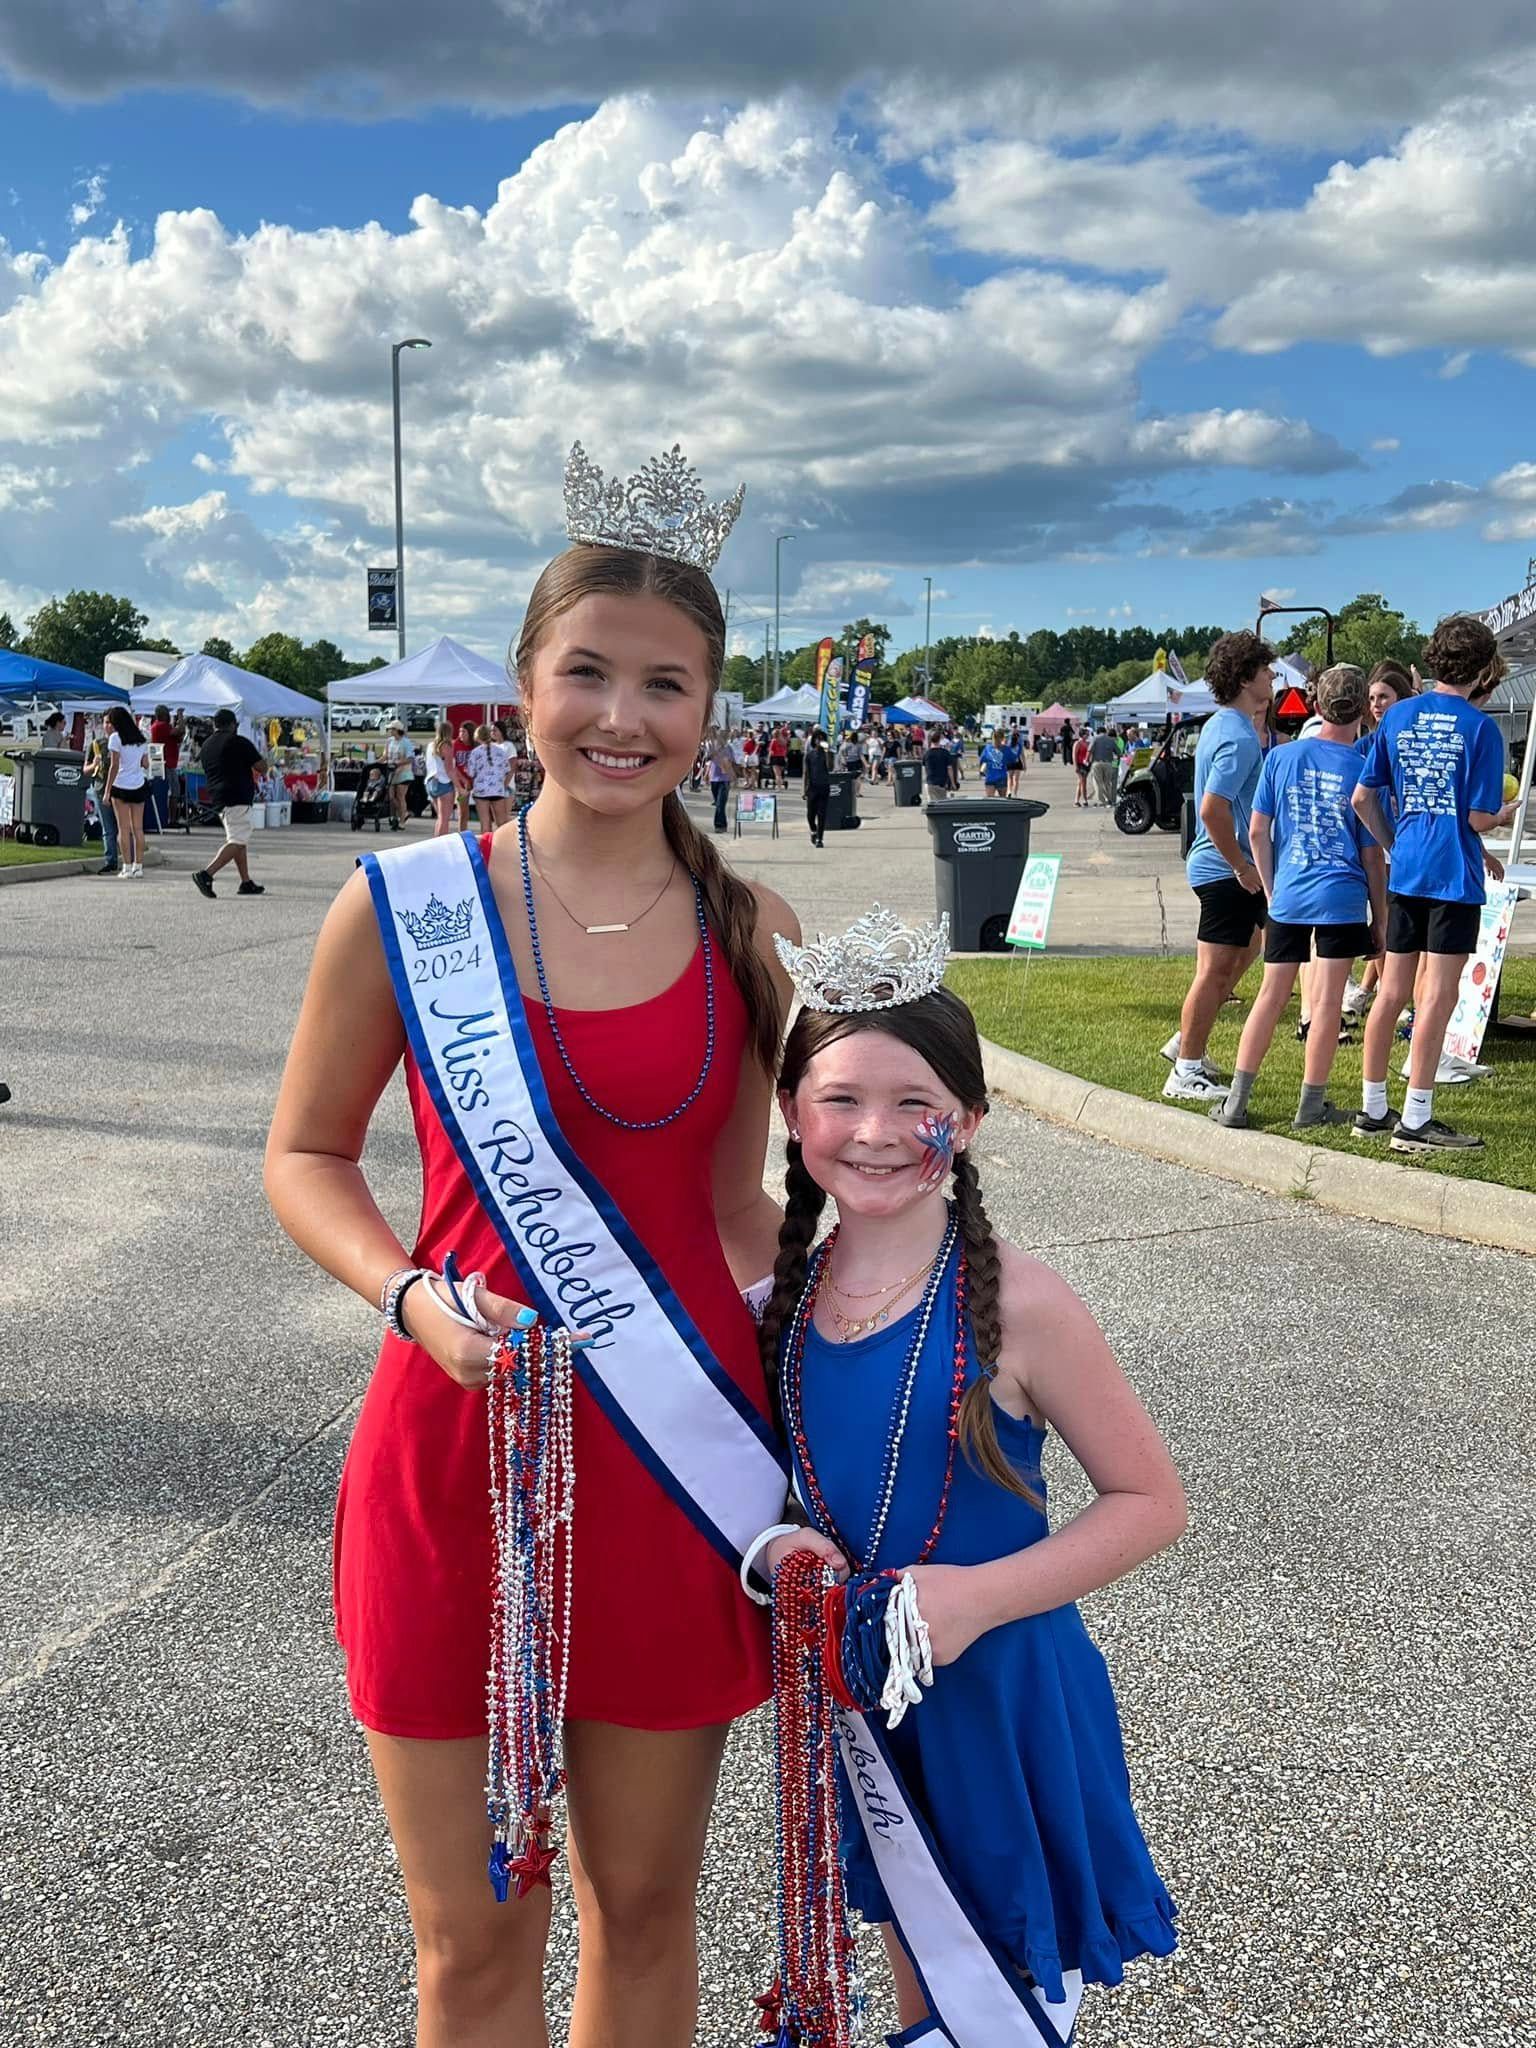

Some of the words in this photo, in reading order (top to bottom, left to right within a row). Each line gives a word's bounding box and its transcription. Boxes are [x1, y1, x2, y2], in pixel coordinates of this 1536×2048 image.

[958, 831, 991, 840] MARTIN
[413, 944, 482, 985] 2024
[1446, 1031, 1469, 1057] TBALL
[429, 999, 500, 1112] Miss
[478, 1119, 635, 1349] Rehobeth
